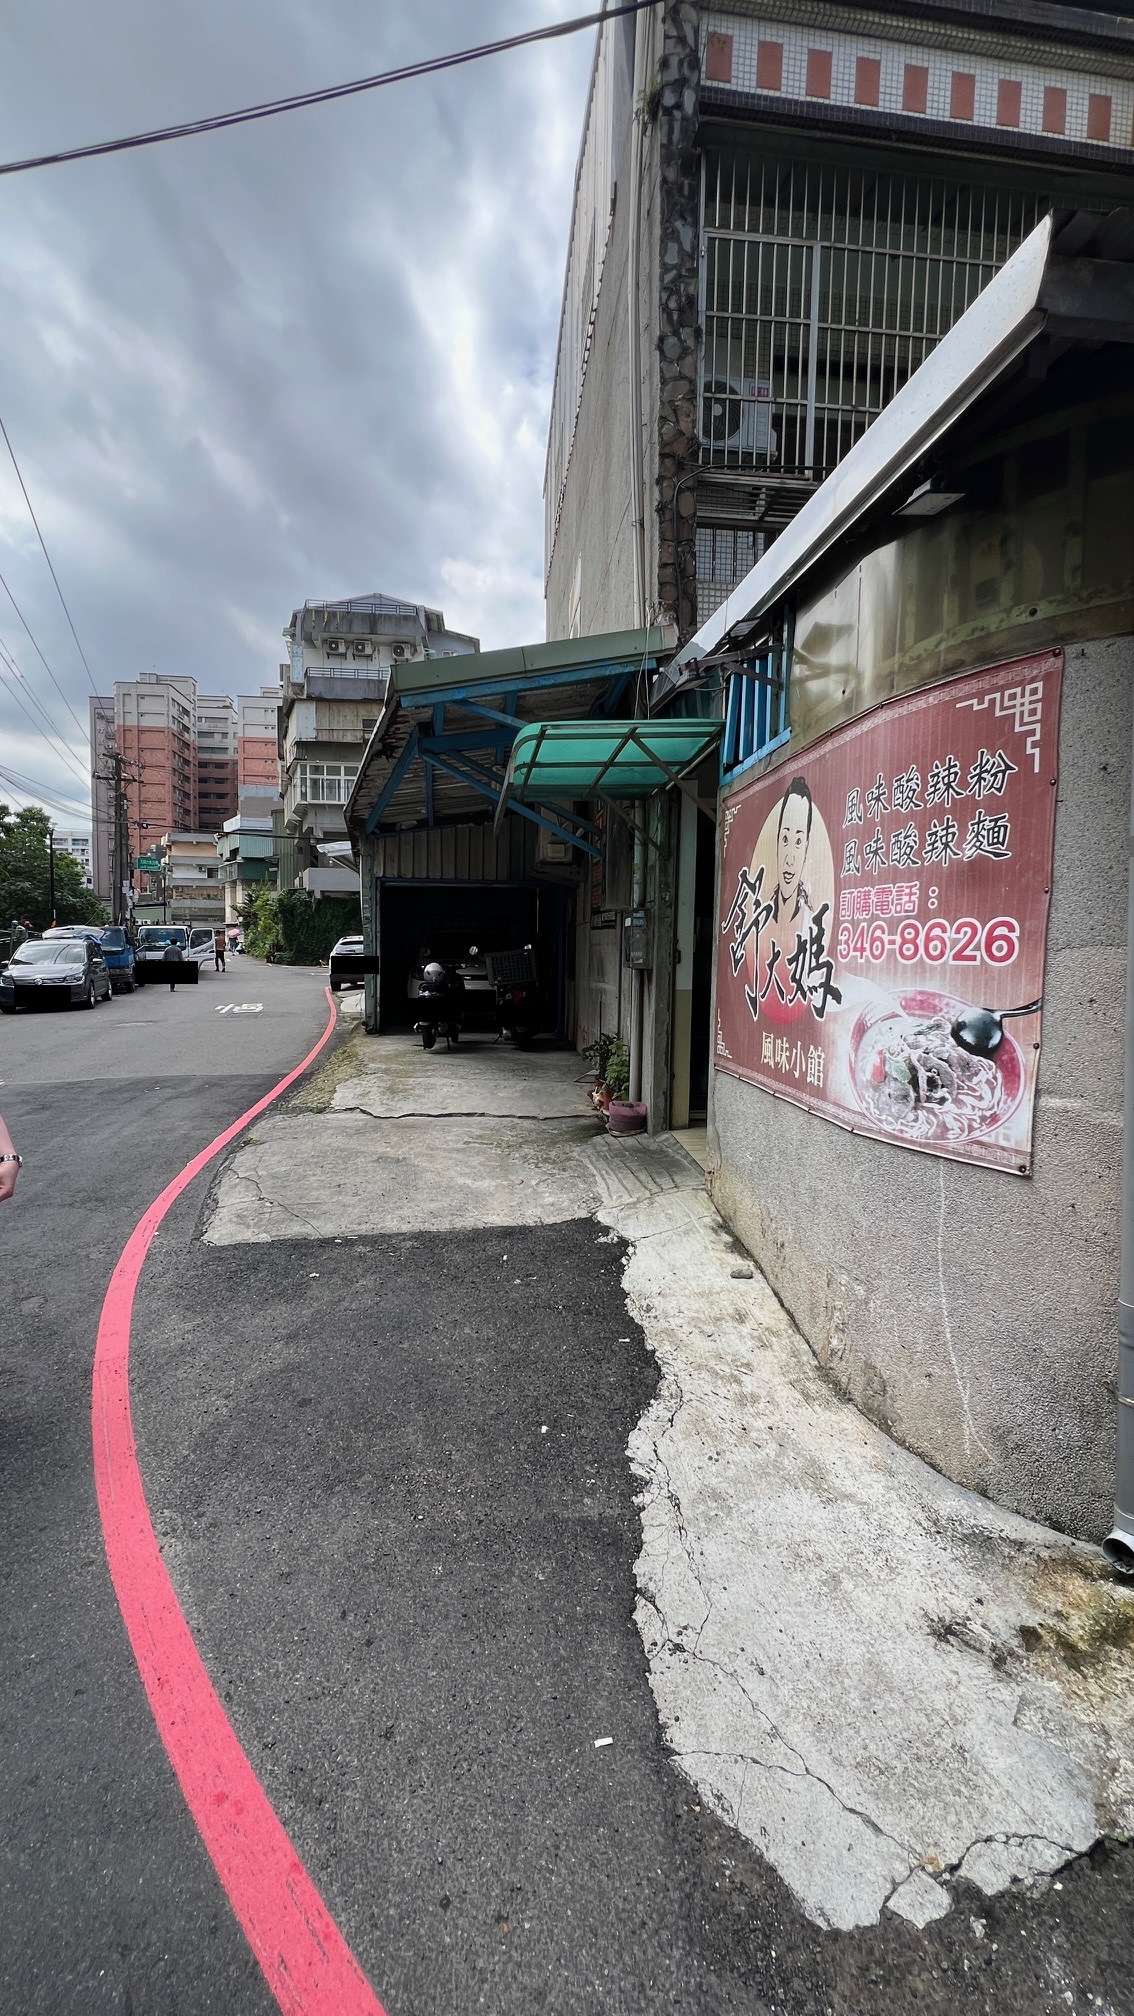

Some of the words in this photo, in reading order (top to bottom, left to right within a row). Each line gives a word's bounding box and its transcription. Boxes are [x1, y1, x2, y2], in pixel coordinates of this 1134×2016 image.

[842, 749, 1018, 829] 風味酸辣粉
[841, 809, 1012, 877] 風味酸辣麵
[838, 916, 1020, 966] 346-8626
[761, 1031, 826, 1088] 風味小館
